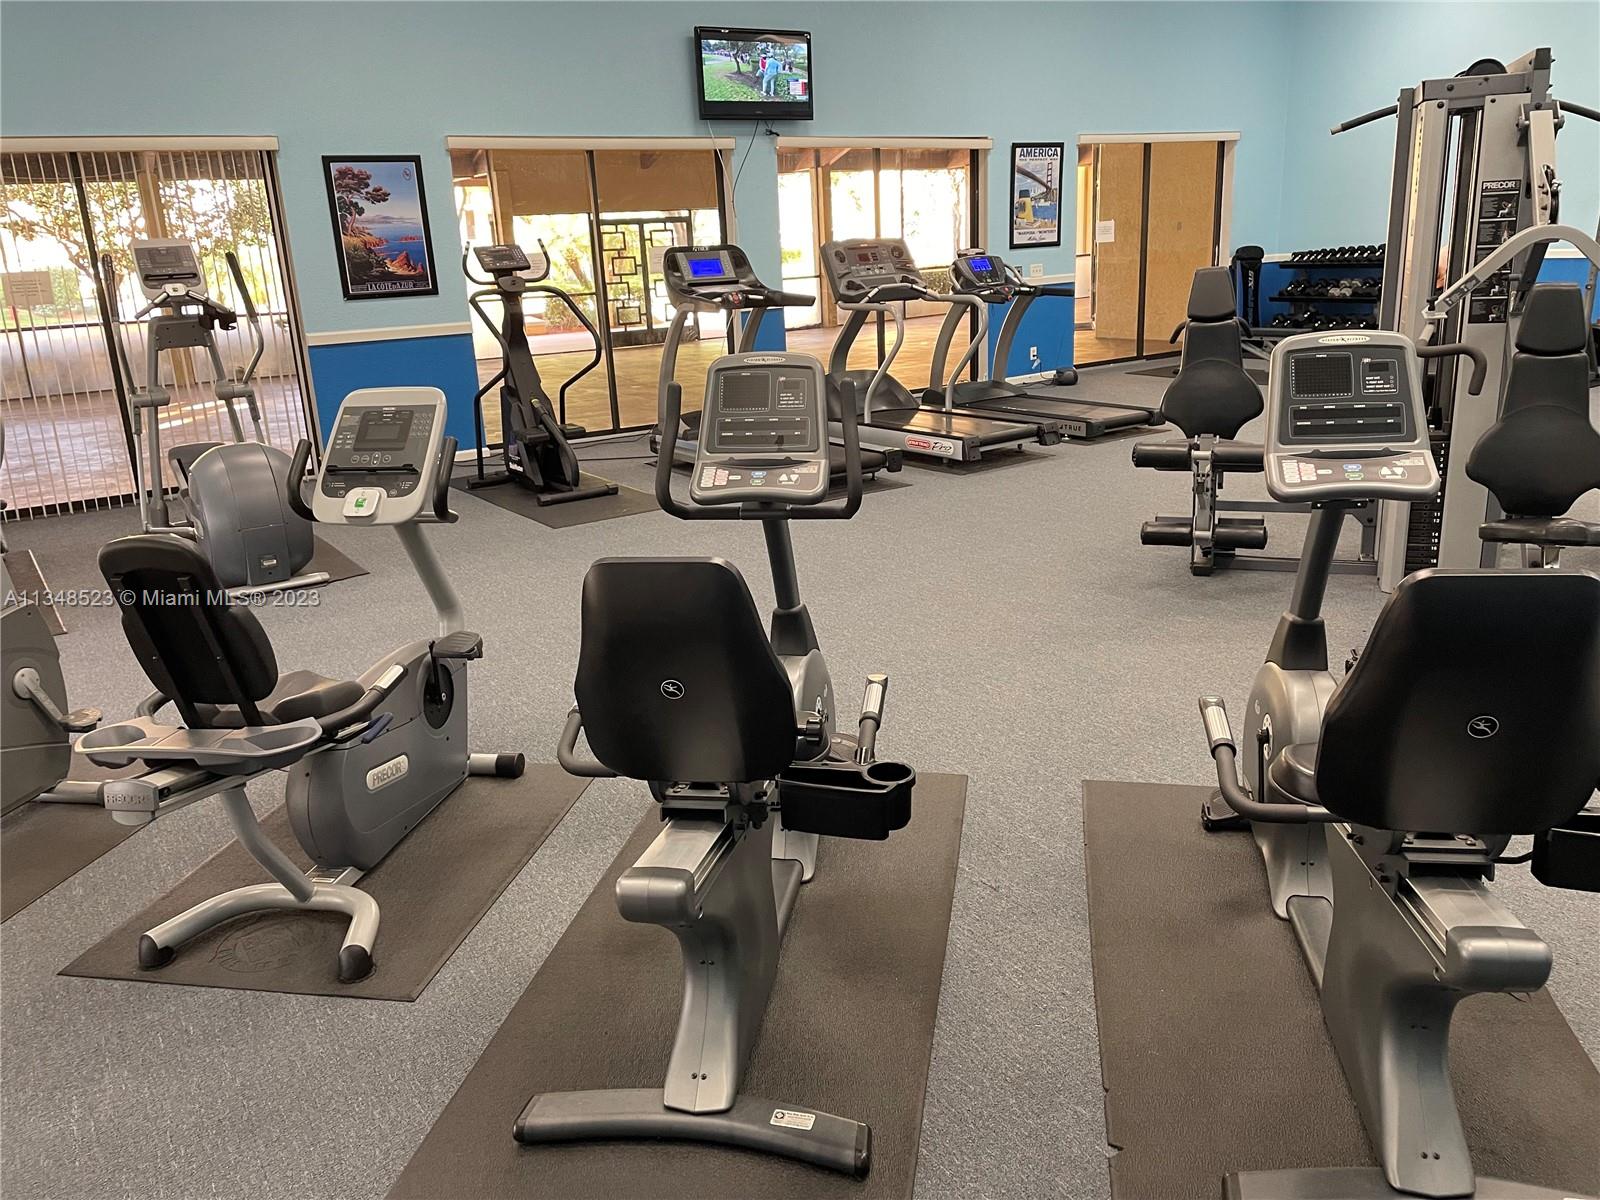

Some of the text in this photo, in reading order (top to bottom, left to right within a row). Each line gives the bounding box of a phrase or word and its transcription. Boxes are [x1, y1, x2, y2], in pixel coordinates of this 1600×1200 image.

[1019, 148, 1059, 158] AMERICA
[1482, 181, 1516, 190] PRECOR
[372, 761, 402, 787] PRECOR
